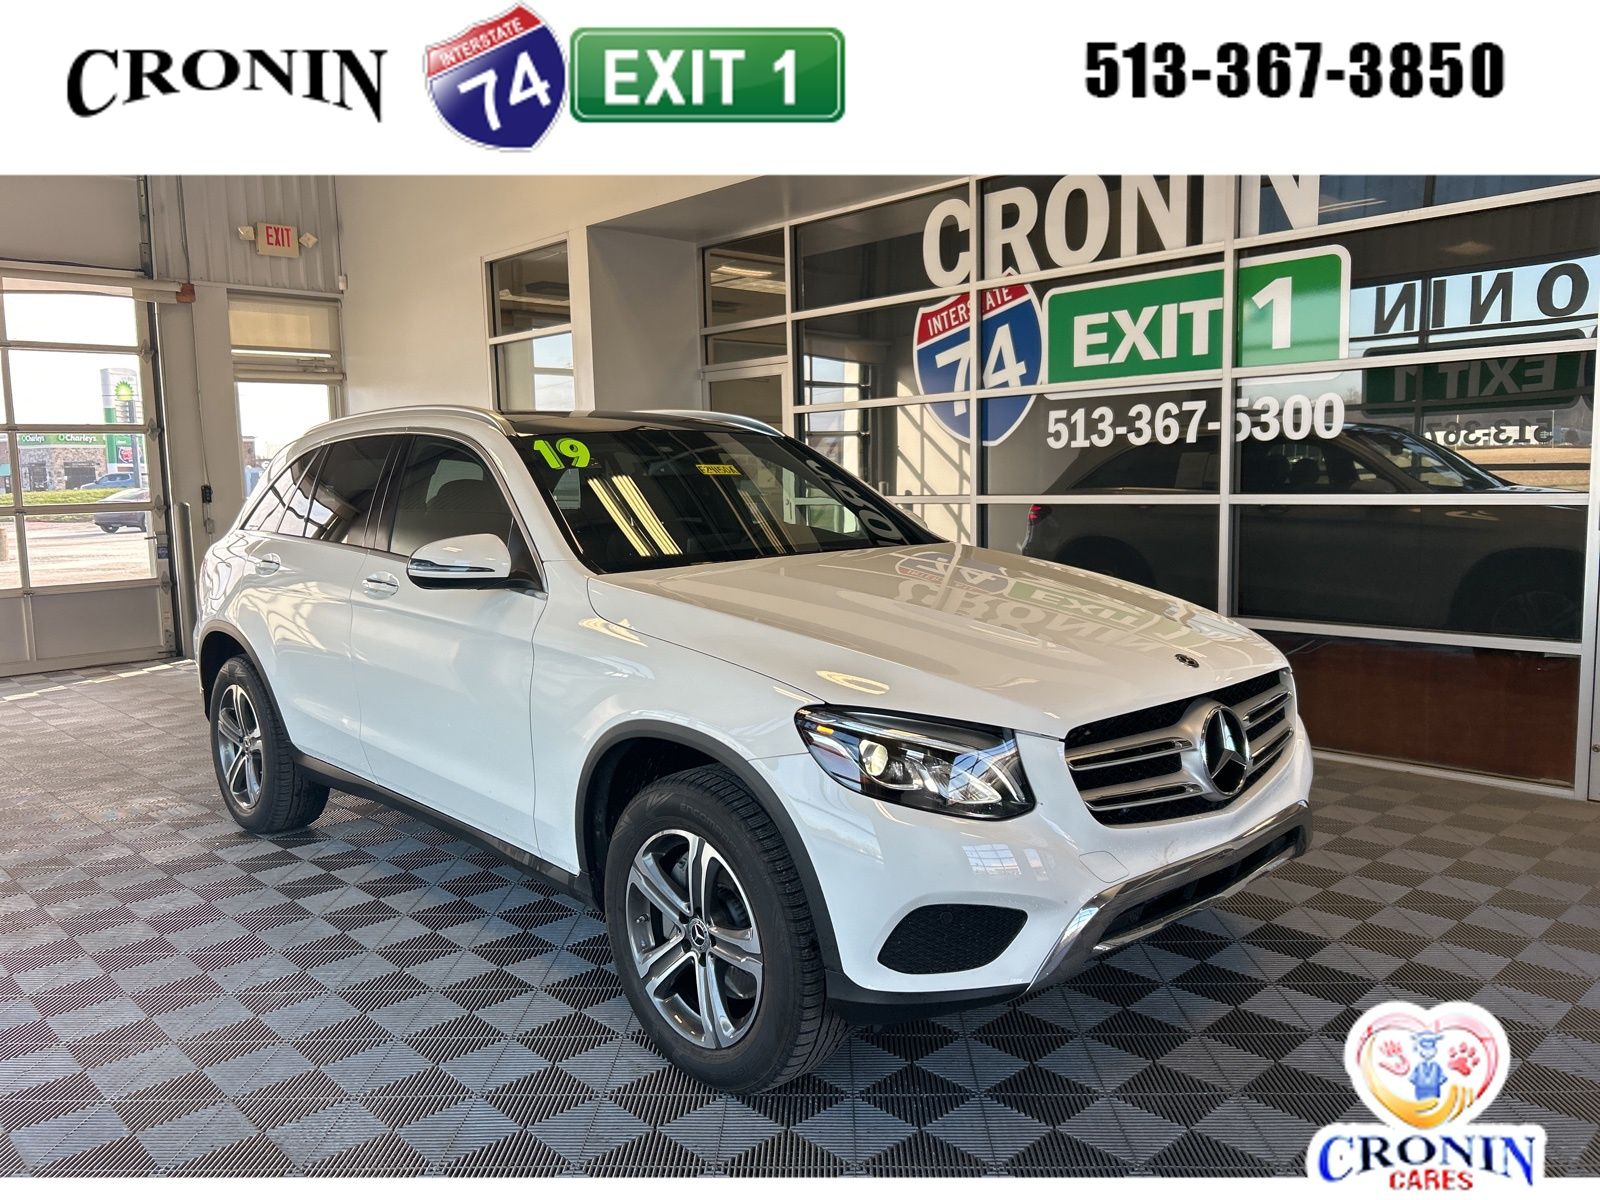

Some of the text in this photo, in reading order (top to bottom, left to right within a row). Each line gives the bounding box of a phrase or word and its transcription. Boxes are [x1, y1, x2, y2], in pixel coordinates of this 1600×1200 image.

[265, 225, 292, 248] EXIT
[922, 175, 1319, 289] CRONIN
[927, 285, 1013, 337] INTERSATE
[1073, 276, 1293, 368] EXIT 1
[935, 324, 1028, 417] 74
[1046, 391, 1346, 449] 513-367-5300
[533, 437, 591, 470] 19
